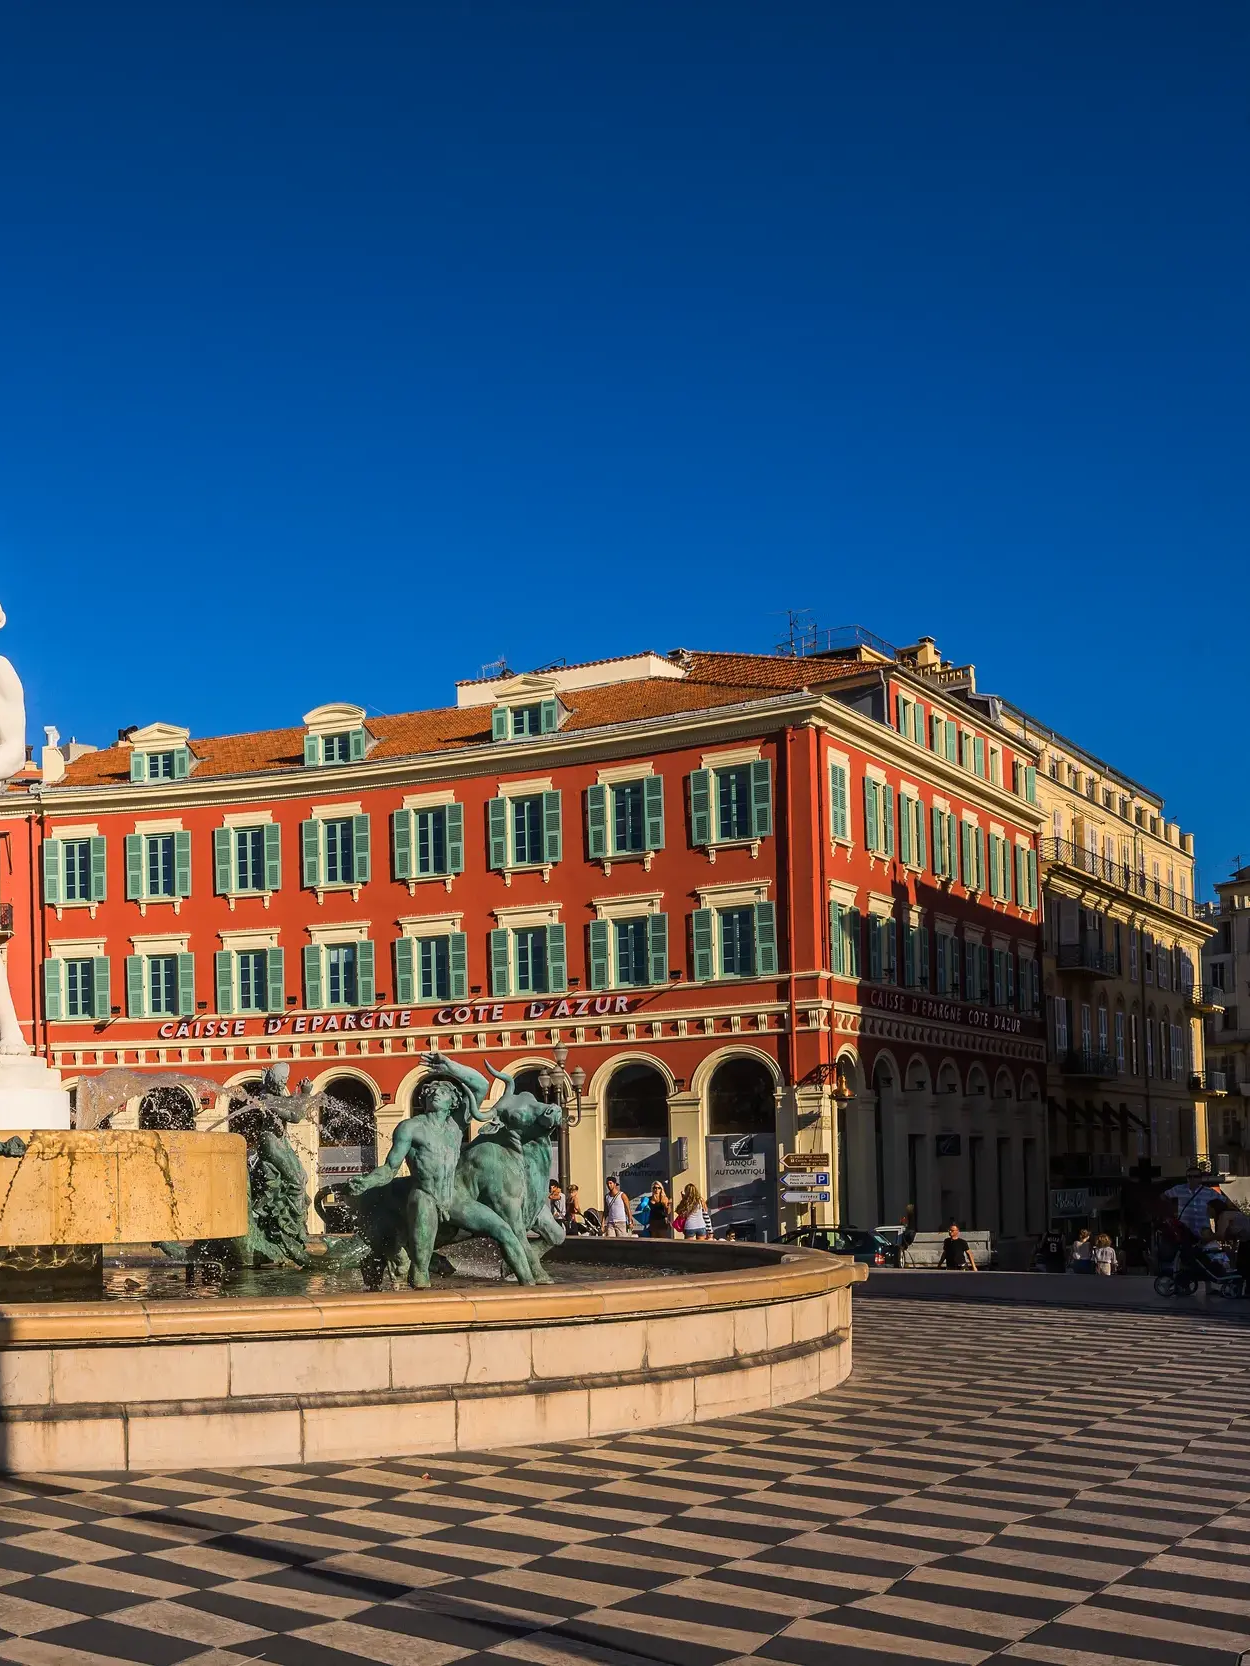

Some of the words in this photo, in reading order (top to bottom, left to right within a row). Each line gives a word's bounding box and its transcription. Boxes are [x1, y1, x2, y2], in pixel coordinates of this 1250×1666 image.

[160, 1020, 246, 1039] CAISSE
[267, 1010, 412, 1034] D'EPARGNE
[437, 1004, 504, 1024] COTE
[529, 996, 629, 1019] D'AZUR
[871, 990, 905, 1010] CAISSE
[912, 999, 962, 1021] D'EPARGNE
[968, 1009, 989, 1027] COTE
[993, 1014, 1021, 1033] D'AZUR
[715, 1168, 767, 1176] AUTOMATIQU
[725, 1159, 757, 1167] BANQUE
